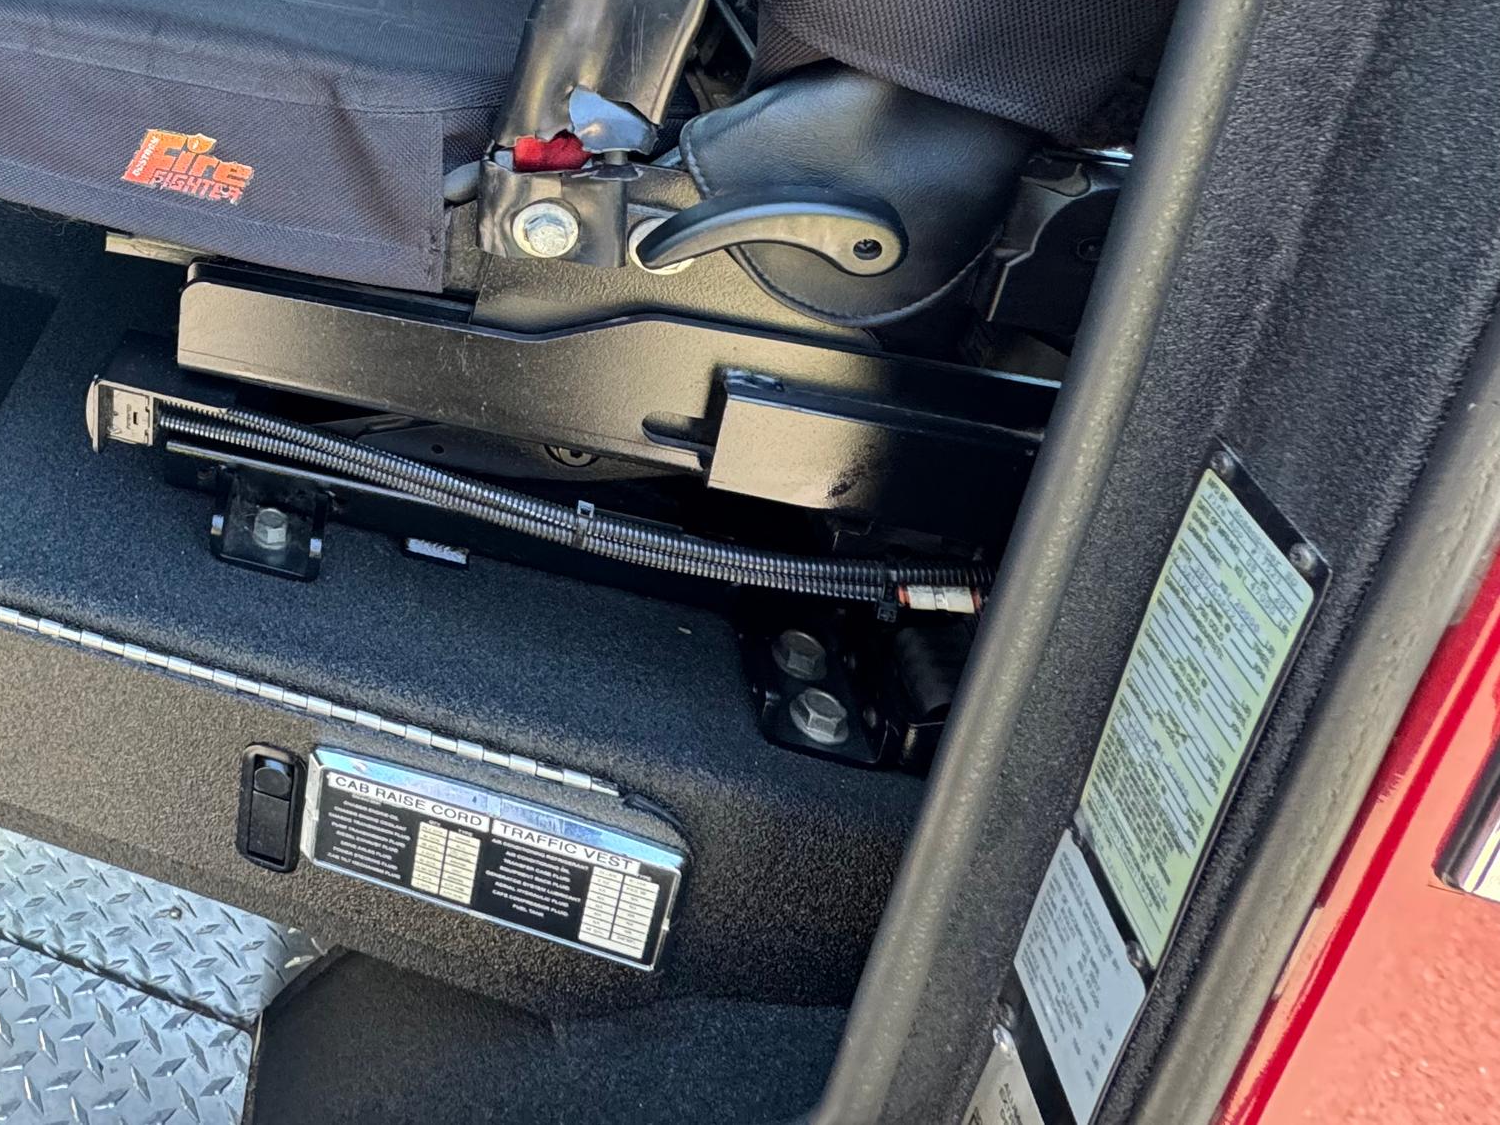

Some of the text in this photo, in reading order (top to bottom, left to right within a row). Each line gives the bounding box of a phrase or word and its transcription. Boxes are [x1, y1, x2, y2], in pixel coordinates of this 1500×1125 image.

[149, 169, 243, 205] FIGHTER
[334, 774, 371, 795] CAB
[374, 786, 427, 811] RAISE
[430, 802, 483, 828] CORD
[490, 836, 589, 872] AIR CONDITIONING REFRIGERANT
[498, 822, 633, 871] TRAFFIC VEST
[502, 857, 571, 883] TRANSFER CASE FLUID
[504, 849, 516, 858] AIR
[516, 853, 560, 872] CONDITIONING
[484, 868, 521, 885] GENERATOR
[550, 880, 571, 892] FLUID
[550, 897, 570, 909] FLUID
